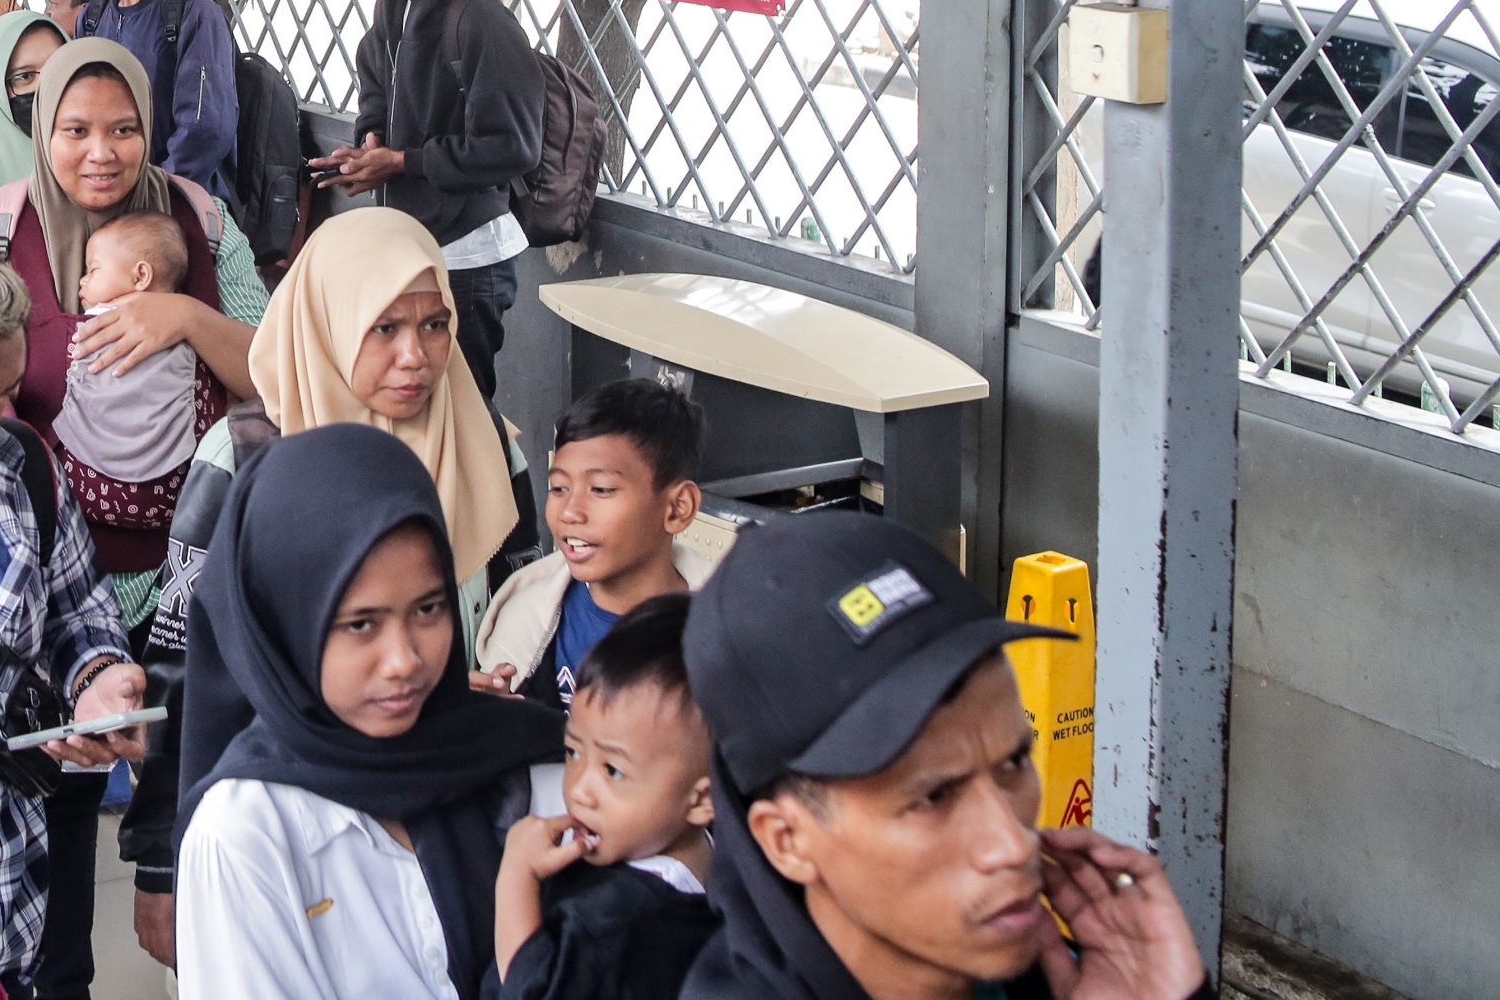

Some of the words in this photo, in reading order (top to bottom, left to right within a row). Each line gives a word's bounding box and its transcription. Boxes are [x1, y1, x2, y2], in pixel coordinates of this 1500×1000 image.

[1057, 706, 1094, 724] CAUTION
[1053, 727, 1071, 741] WET
[1072, 722, 1094, 737] FLOO
